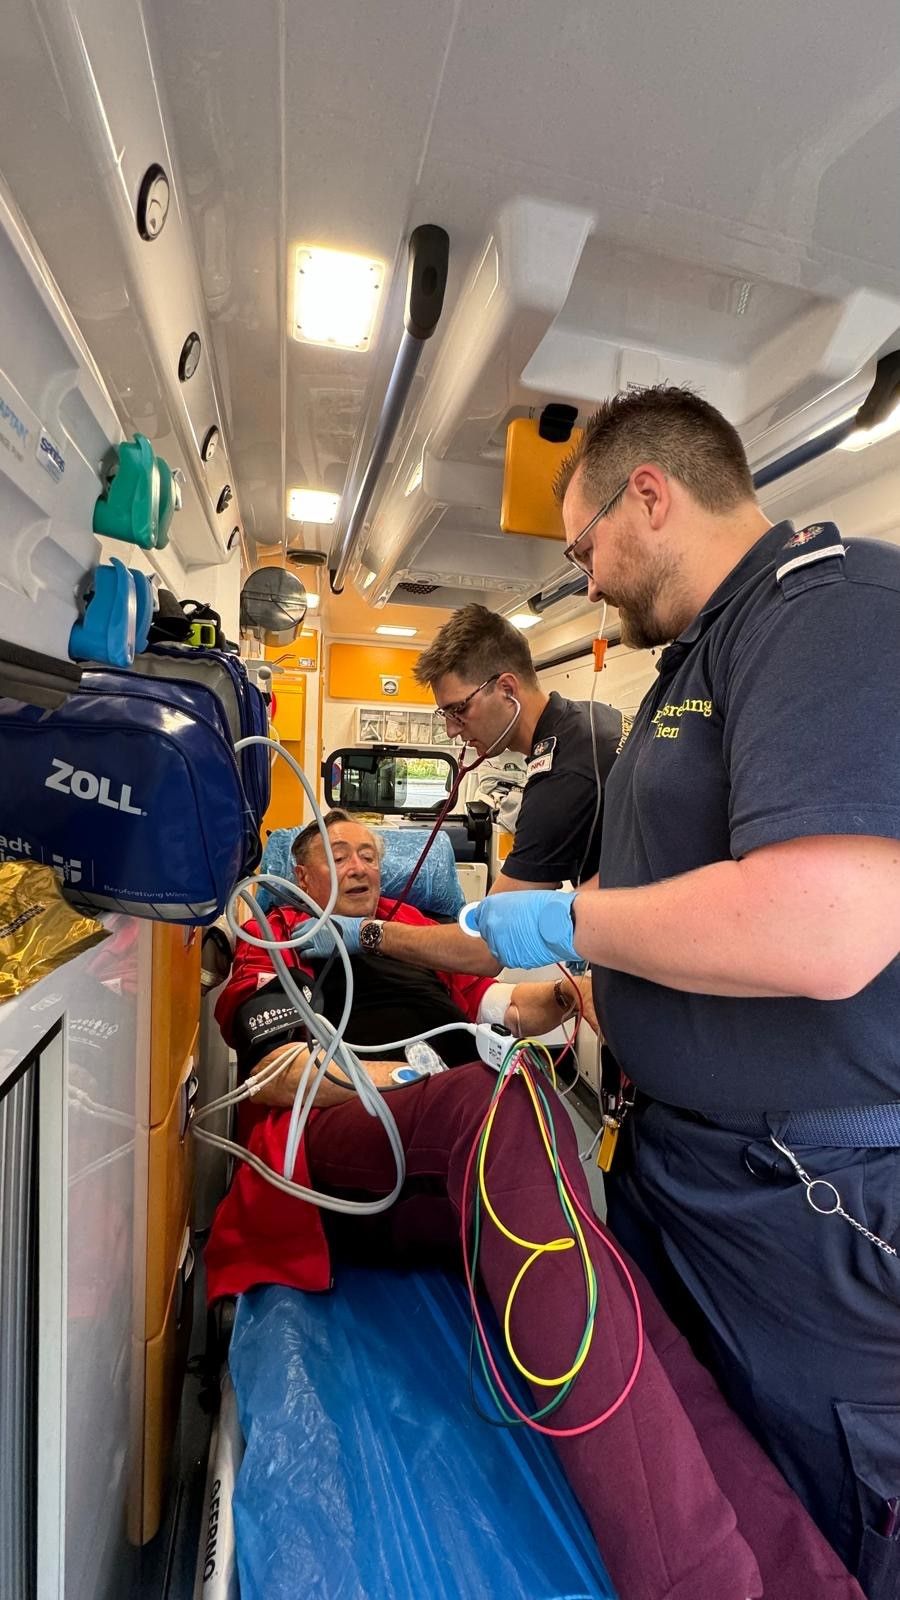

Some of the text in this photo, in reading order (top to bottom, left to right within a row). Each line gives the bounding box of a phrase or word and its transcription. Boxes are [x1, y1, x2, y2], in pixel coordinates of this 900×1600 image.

[653, 723, 679, 739] ien
[45, 758, 142, 816] ZOLL
[0, 834, 32, 856] adt
